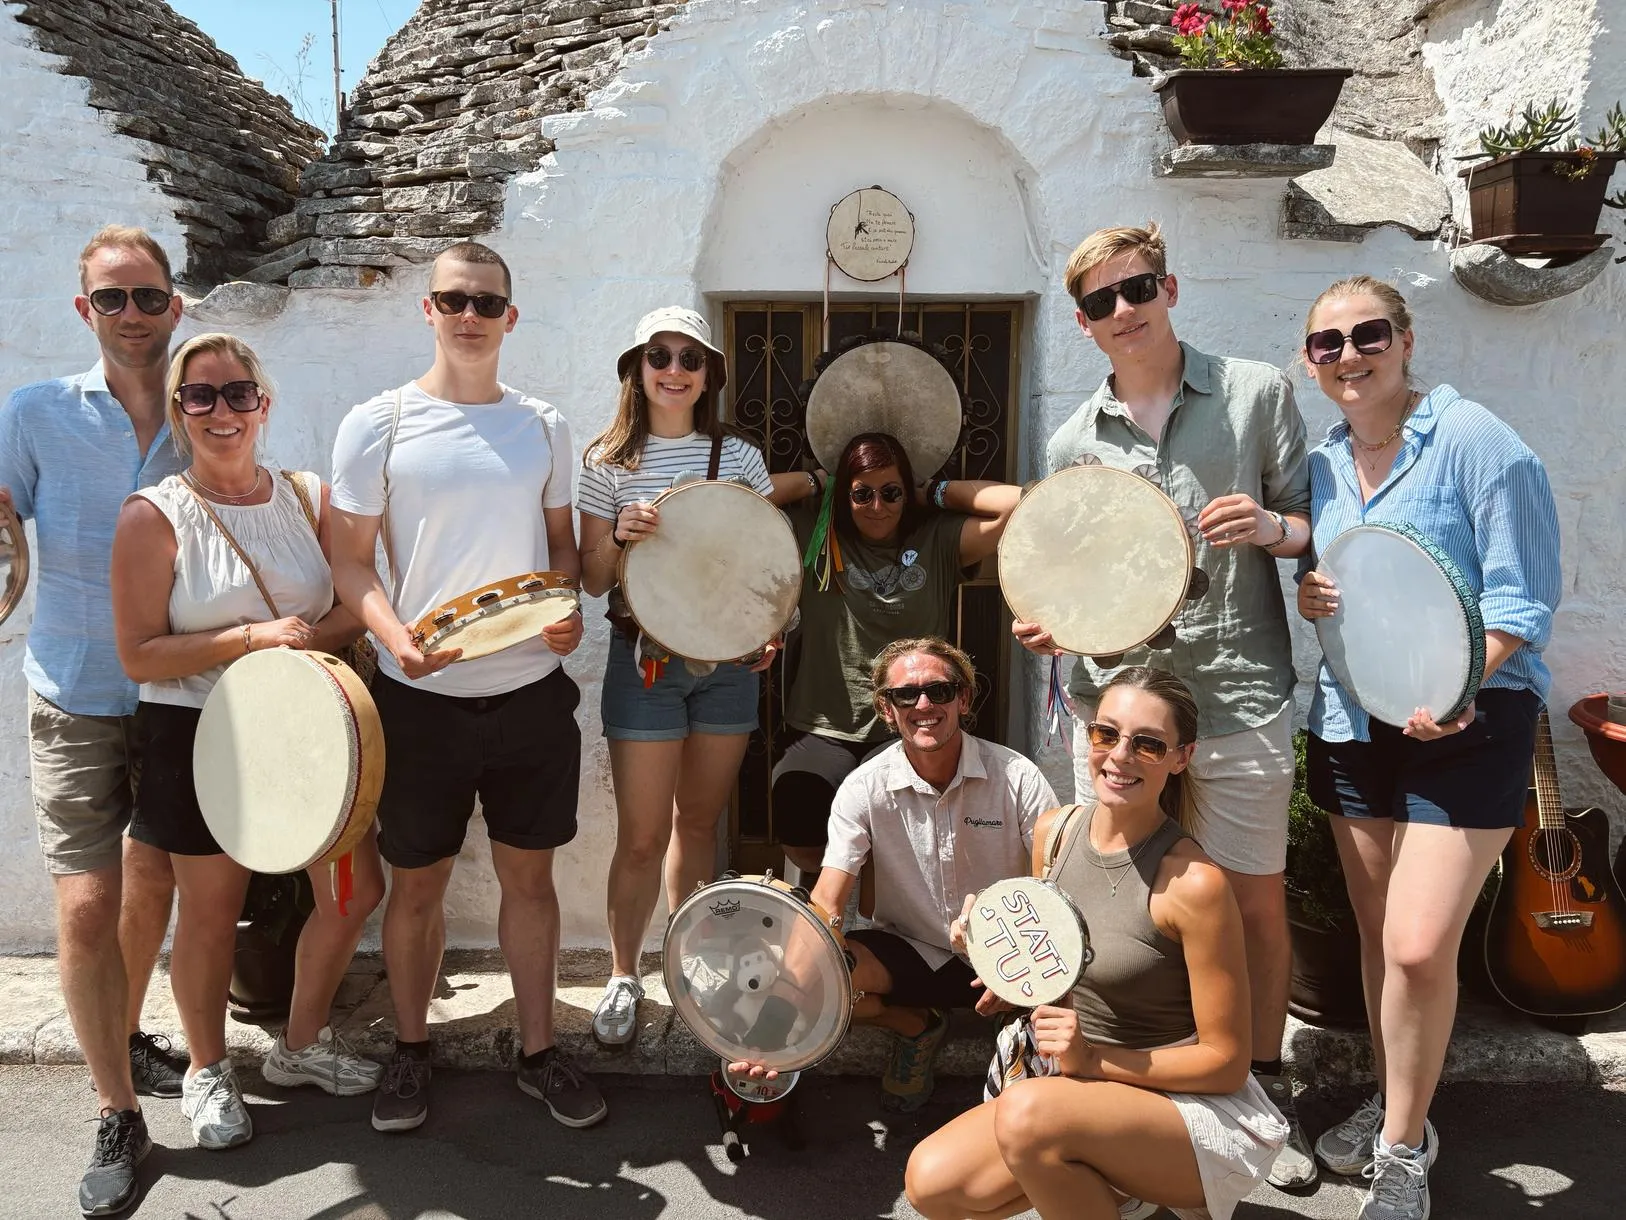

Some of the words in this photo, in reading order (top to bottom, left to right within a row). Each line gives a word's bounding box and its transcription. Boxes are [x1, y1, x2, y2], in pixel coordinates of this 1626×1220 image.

[714, 904, 738, 914] REMO
[984, 917, 1030, 983] TU
[1001, 890, 1069, 979] STATT
[756, 1085, 768, 1096] 10
